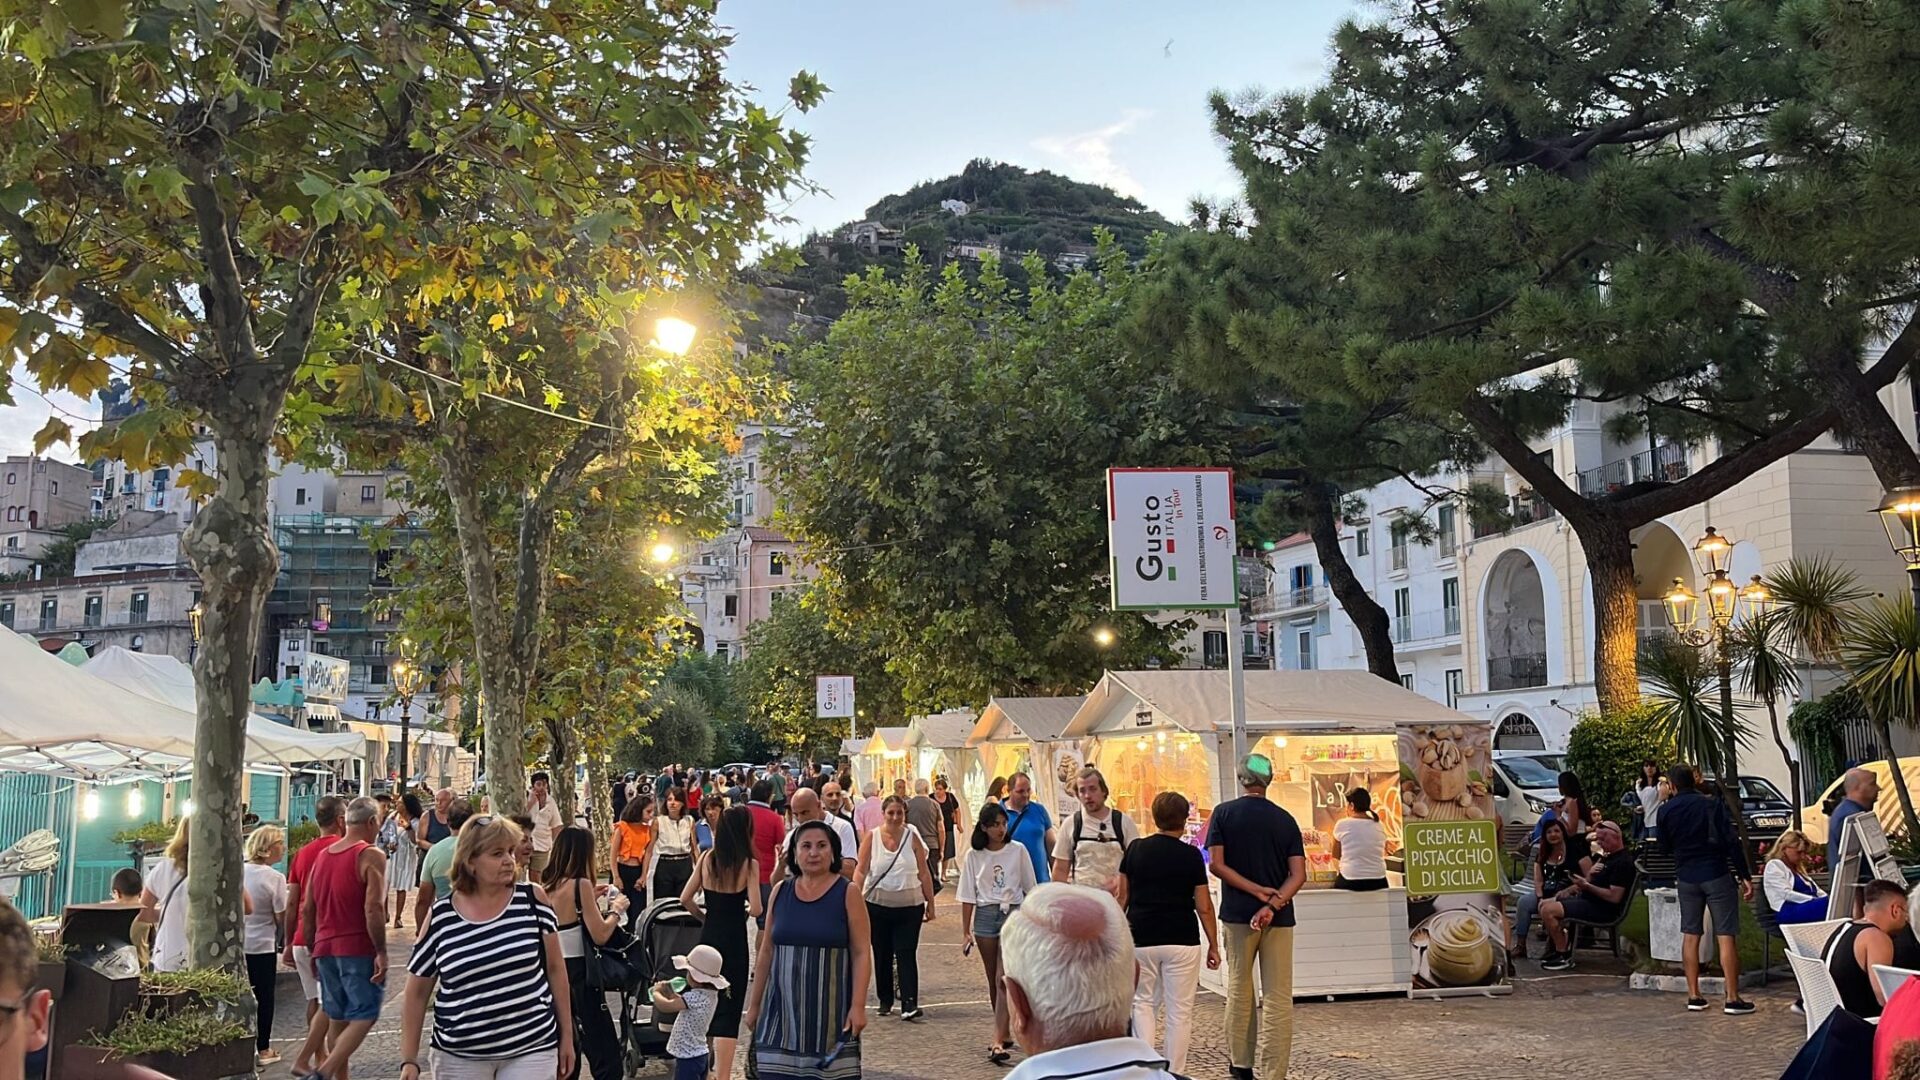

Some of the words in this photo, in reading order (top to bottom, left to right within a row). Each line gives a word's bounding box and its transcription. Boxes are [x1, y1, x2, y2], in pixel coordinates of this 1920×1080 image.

[1172, 488, 1181, 508] Tour
[1164, 496, 1174, 535] ITALIA
[1136, 496, 1163, 581] Gusto
[824, 684, 833, 710] Gusto
[1314, 780, 1334, 808] La
[1416, 829, 1464, 845] CREME
[1468, 828, 1485, 844] AL
[1411, 848, 1493, 866] PISTACCHIO
[1421, 871, 1436, 887] DI
[1440, 869, 1486, 886] SICILIA
